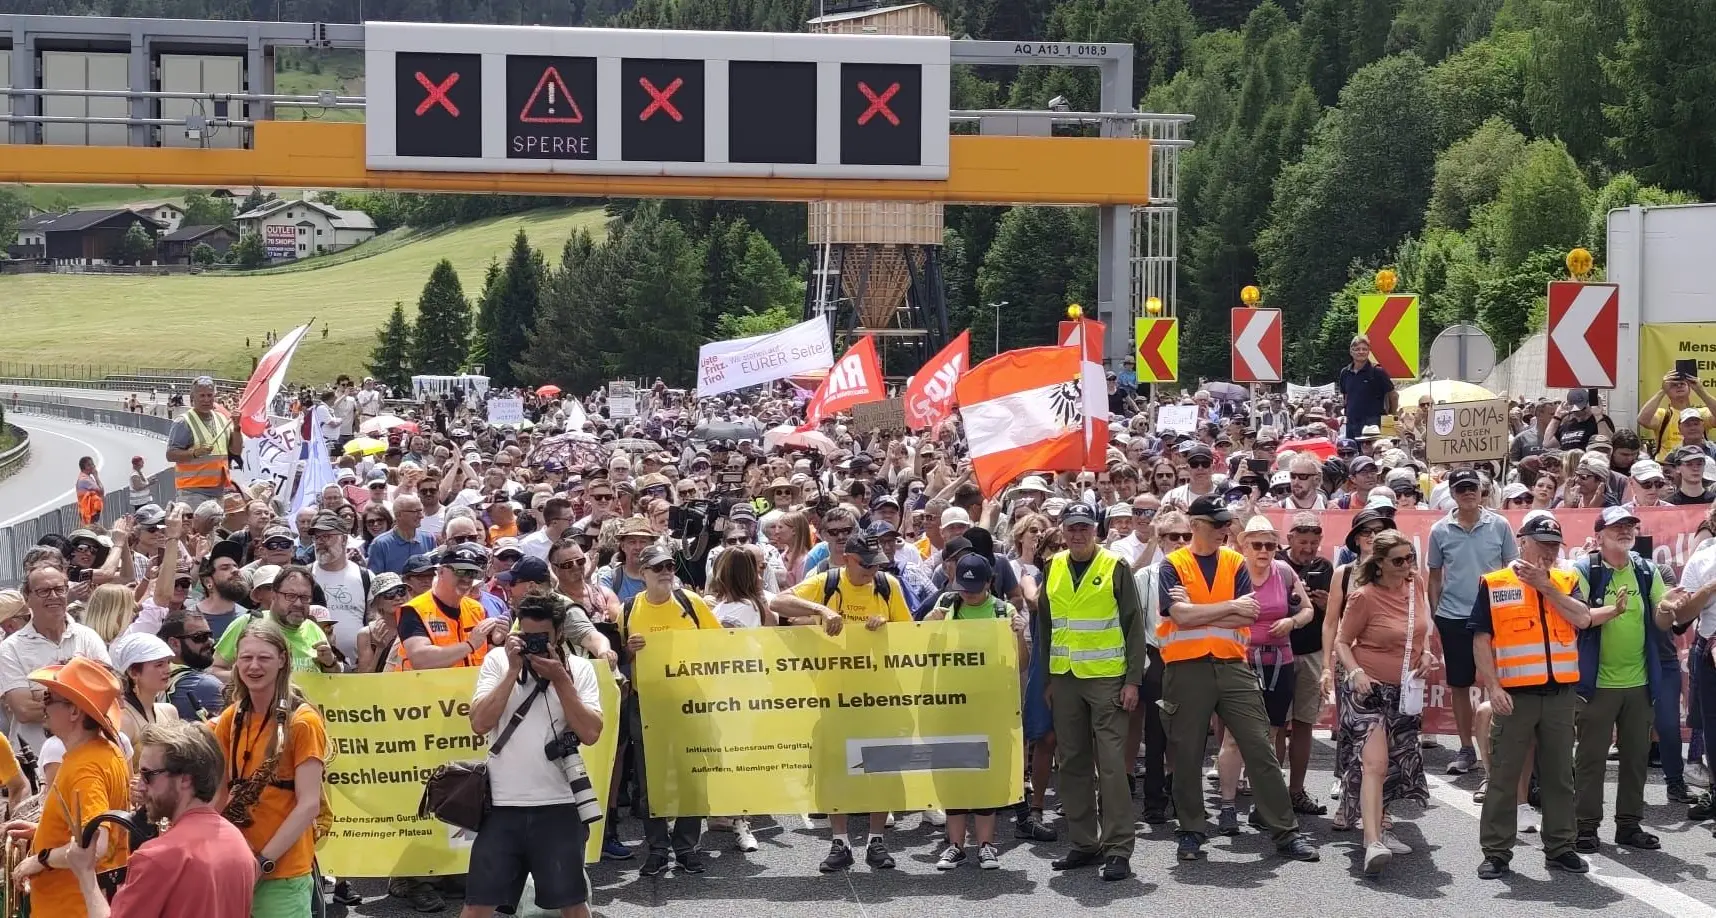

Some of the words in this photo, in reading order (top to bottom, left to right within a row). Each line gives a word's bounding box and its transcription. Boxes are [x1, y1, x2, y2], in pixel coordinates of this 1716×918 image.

[513, 135, 591, 154] SPERRE
[267, 226, 295, 234] OUTLET
[741, 351, 789, 374] EURER
[790, 340, 827, 361] Seite!
[702, 372, 725, 386] Tirol
[1460, 428, 1491, 438] GEGEN
[1440, 436, 1502, 456] TRANSIT
[1492, 588, 1522, 603] FEUERWEHR
[664, 659, 770, 678] LÄRMFREI,
[776, 655, 878, 672] STAUFREI,
[884, 652, 986, 669] MAUTFREI
[393, 704, 431, 721] vor
[437, 699, 471, 718] Ve
[681, 696, 741, 715] durch
[748, 695, 831, 711] unseren
[838, 692, 967, 708] Lebensraum
[375, 738, 417, 754] zum
[423, 734, 489, 752] Fernp
[724, 743, 775, 753] Lebensraum
[781, 762, 813, 770] Plateau
[322, 765, 441, 786] eschleunig
[333, 814, 395, 824] Lebensraum
[343, 829, 396, 840] Mieminger
[399, 828, 433, 837] Plateau
